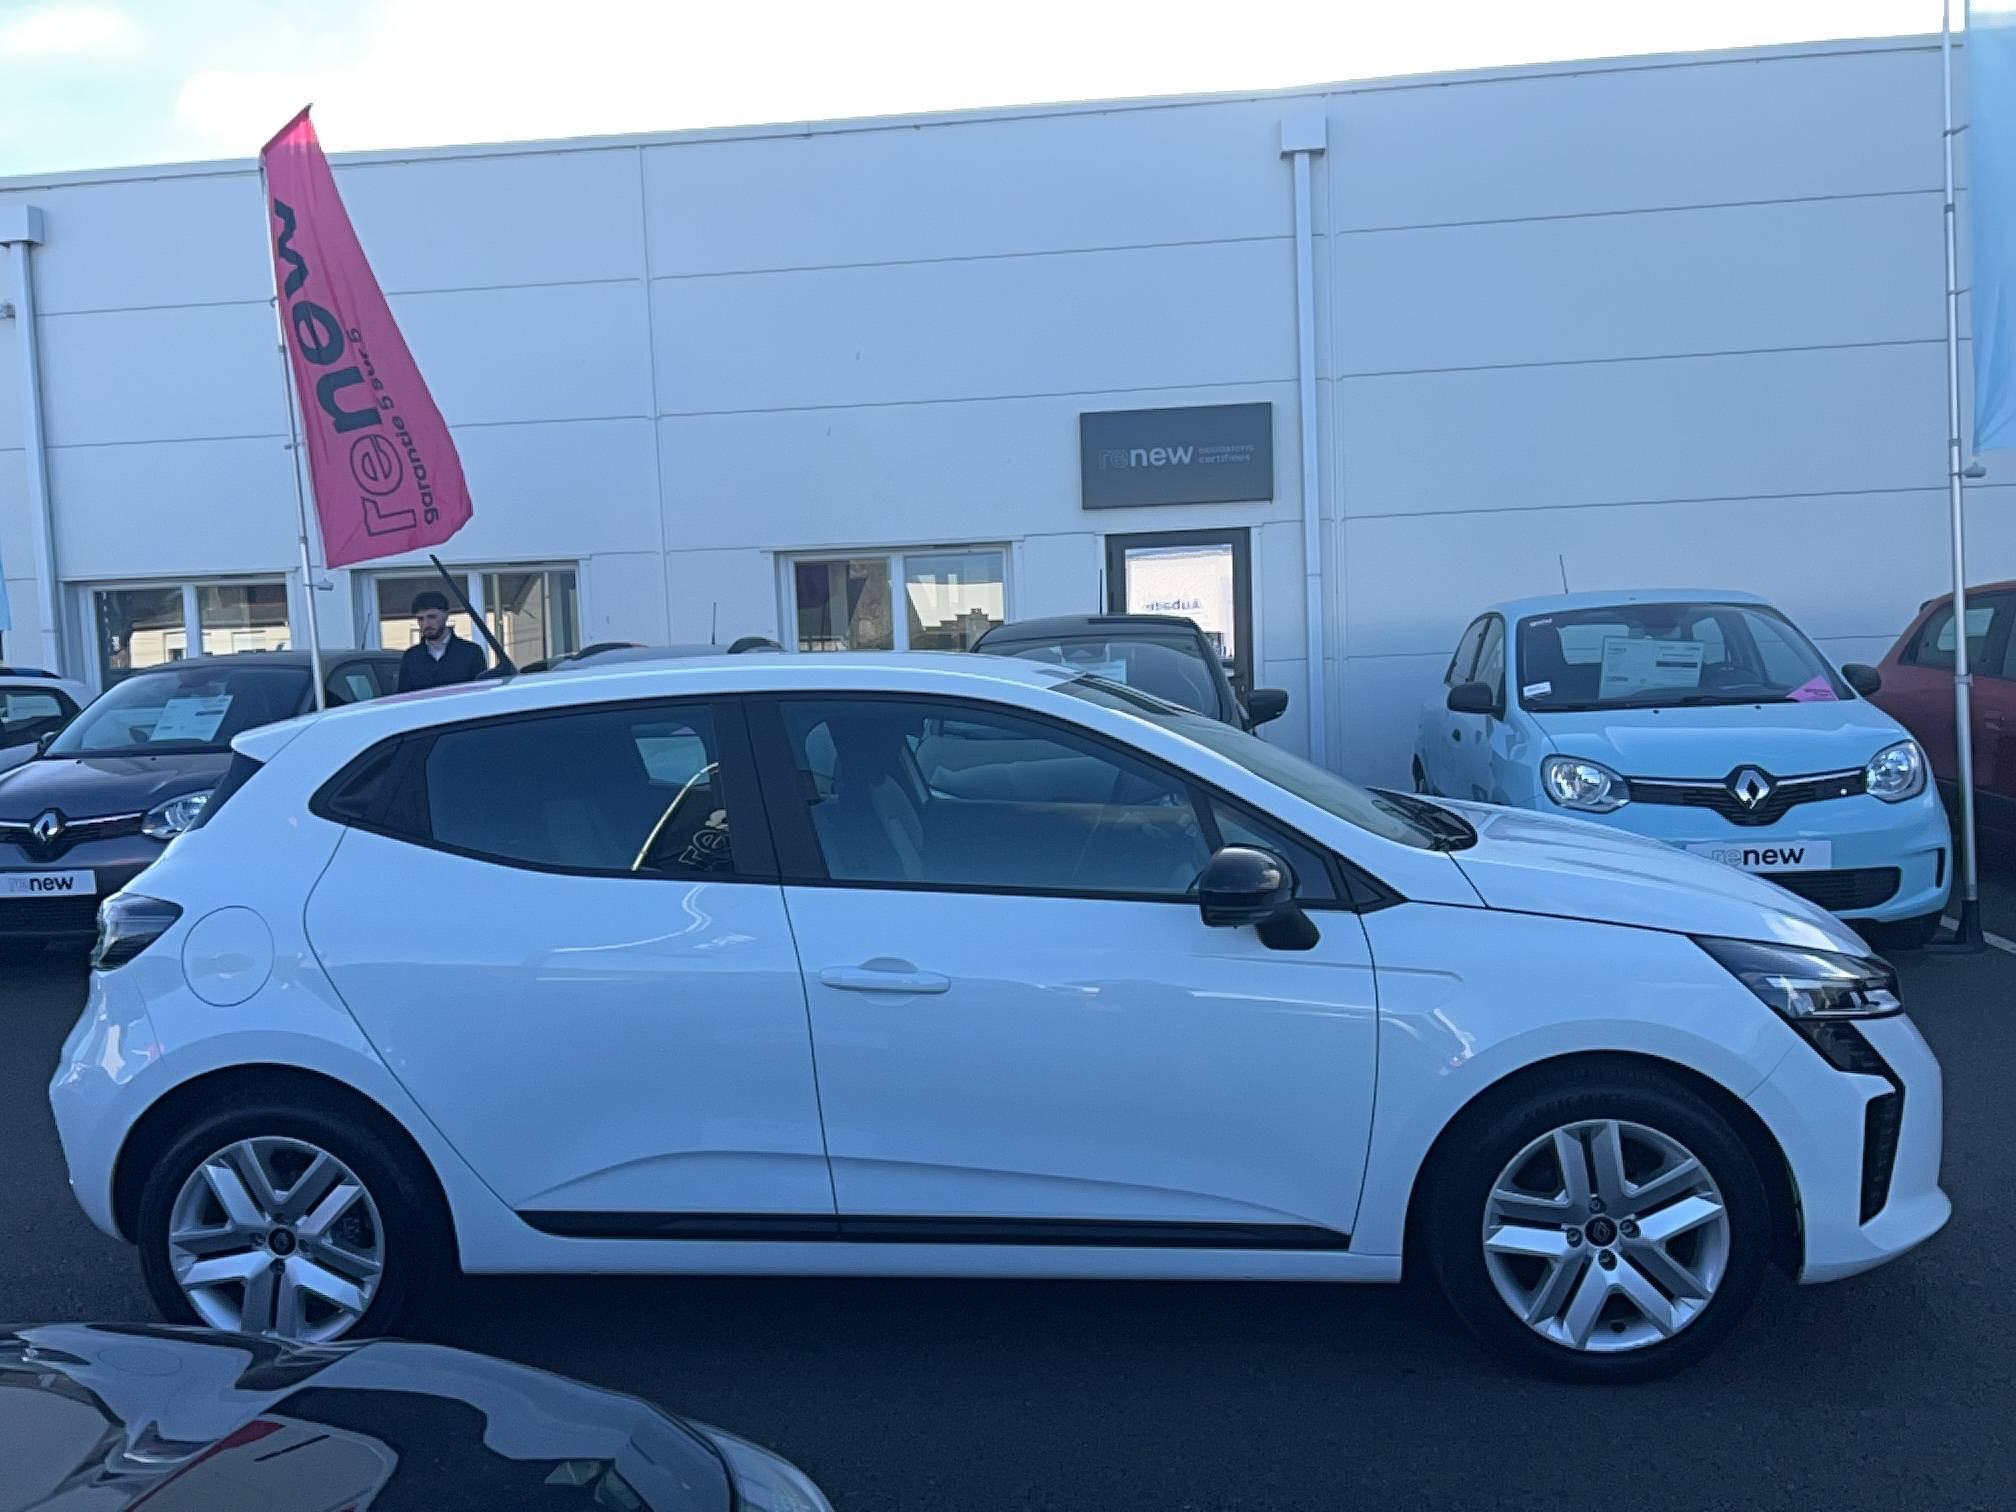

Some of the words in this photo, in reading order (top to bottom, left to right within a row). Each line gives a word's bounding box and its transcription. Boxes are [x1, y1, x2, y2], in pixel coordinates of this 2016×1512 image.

[348, 328, 362, 343] 5
[274, 198, 417, 537] renew
[358, 348, 384, 391] sur
[377, 395, 394, 410] 5
[392, 415, 439, 525] garantie
[1099, 445, 1194, 470] renew
[1711, 847, 1806, 867] renew
